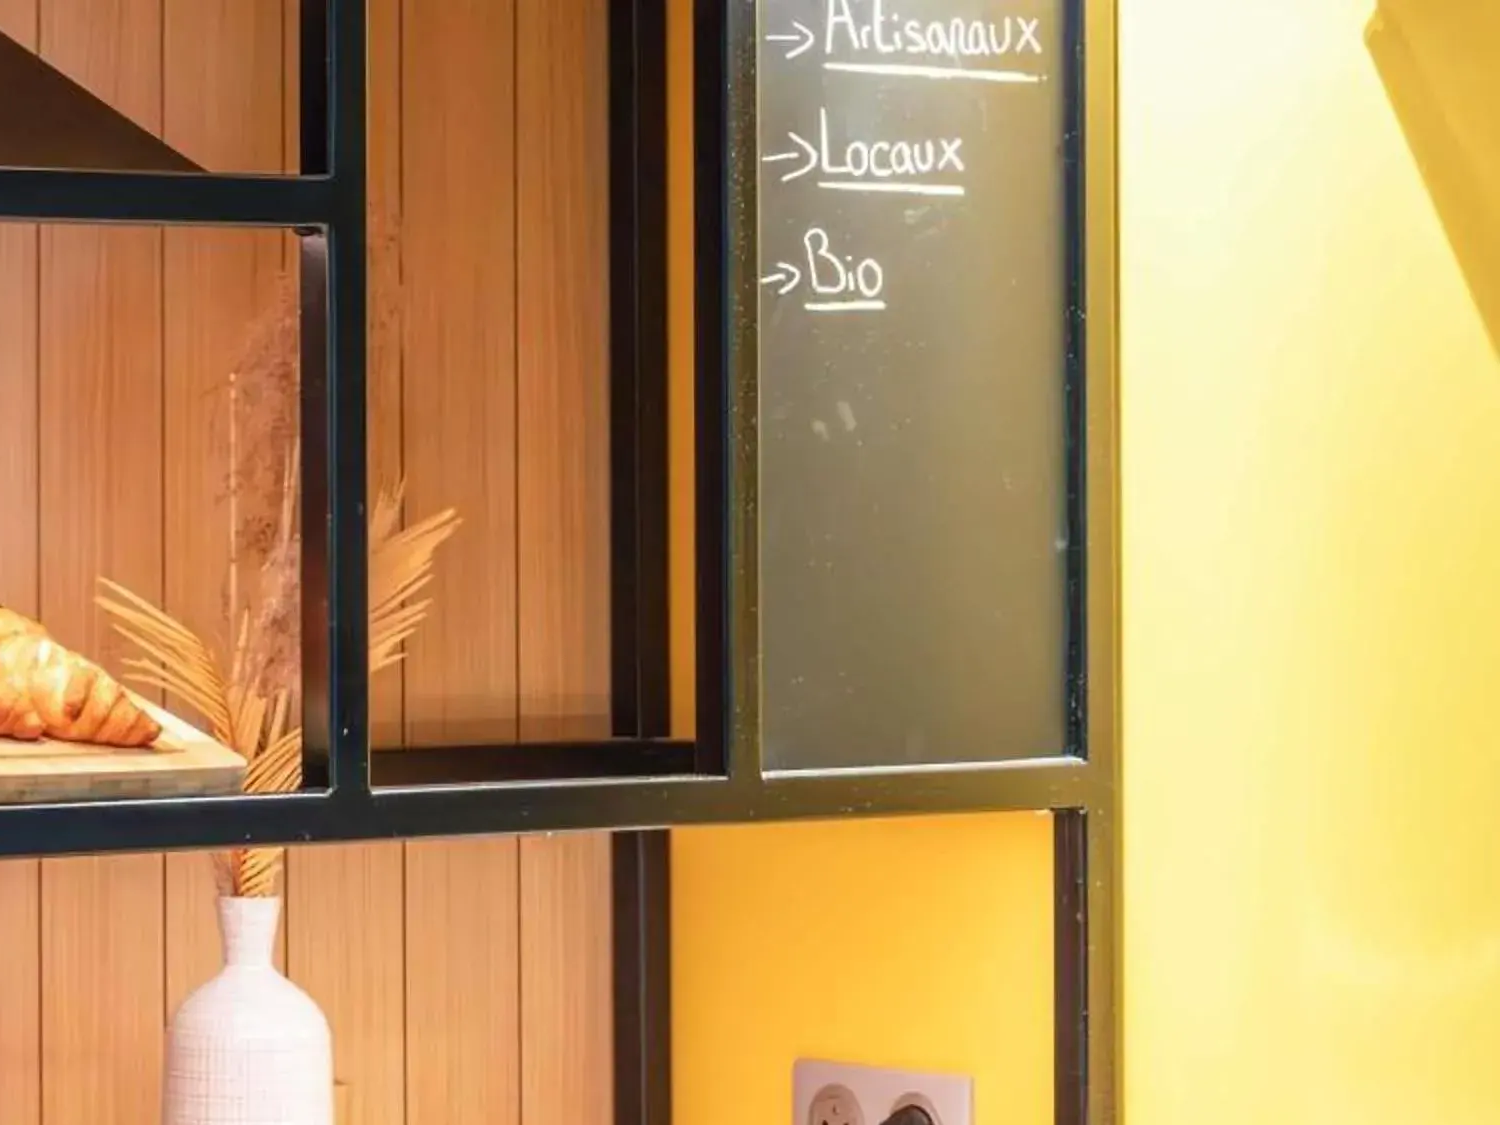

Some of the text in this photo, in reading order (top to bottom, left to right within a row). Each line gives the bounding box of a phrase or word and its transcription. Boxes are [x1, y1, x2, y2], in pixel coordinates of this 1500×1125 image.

[825, 0, 1043, 54] Artisanaux
[820, 106, 965, 176] Locaux
[803, 228, 883, 297] Bio
